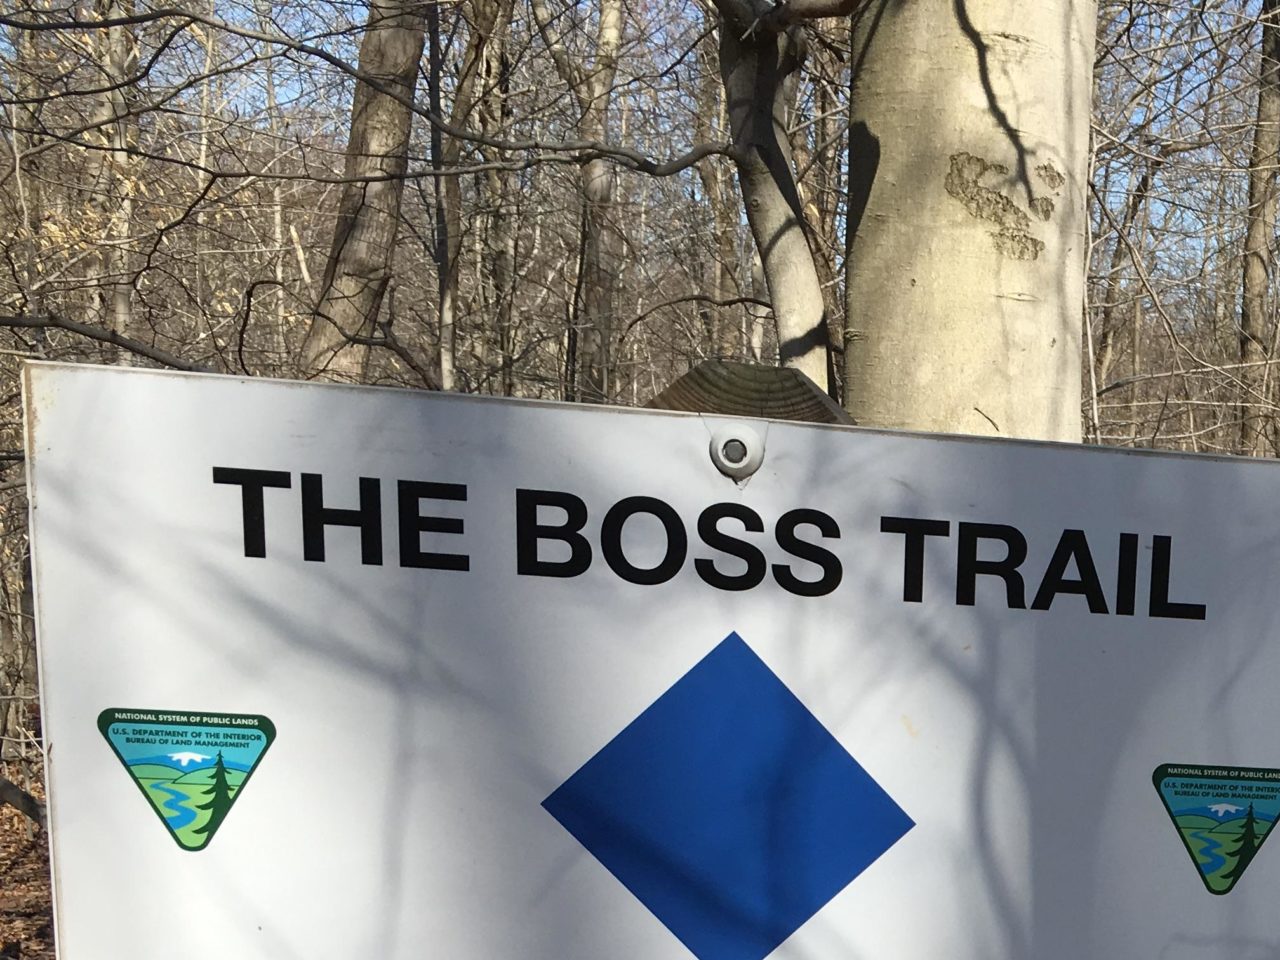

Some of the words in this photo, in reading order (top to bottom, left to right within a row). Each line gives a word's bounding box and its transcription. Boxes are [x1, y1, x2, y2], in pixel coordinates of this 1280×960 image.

[213, 467, 470, 571] THE
[516, 488, 843, 598] BOSS
[880, 516, 1206, 620] TRAIL
[114, 712, 157, 721] NATIONAL
[158, 714, 188, 722] SYSTEM
[202, 716, 231, 724] PUBLIC
[232, 718, 259, 726] LANDS
[112, 727, 129, 736] U.S.
[132, 728, 188, 738] DEPARTMENT
[190, 731, 202, 739] OF
[205, 731, 220, 739] THE
[222, 732, 262, 742] INTERIOR
[125, 736, 157, 745] BUREAU
[171, 738, 193, 746] LAND
[194, 740, 250, 749] MANAGEMENT
[1167, 767, 1202, 776] NATIONAL
[1203, 769, 1228, 777] SYSTEM
[1164, 781, 1178, 789] U.S.
[1180, 782, 1227, 791] DEPARTMENT
[1229, 784, 1239, 792] OF
[1174, 789, 1200, 798] BUREAU
[1211, 791, 1230, 799] LAND
[1231, 792, 1278, 801] MANAGEMENT
